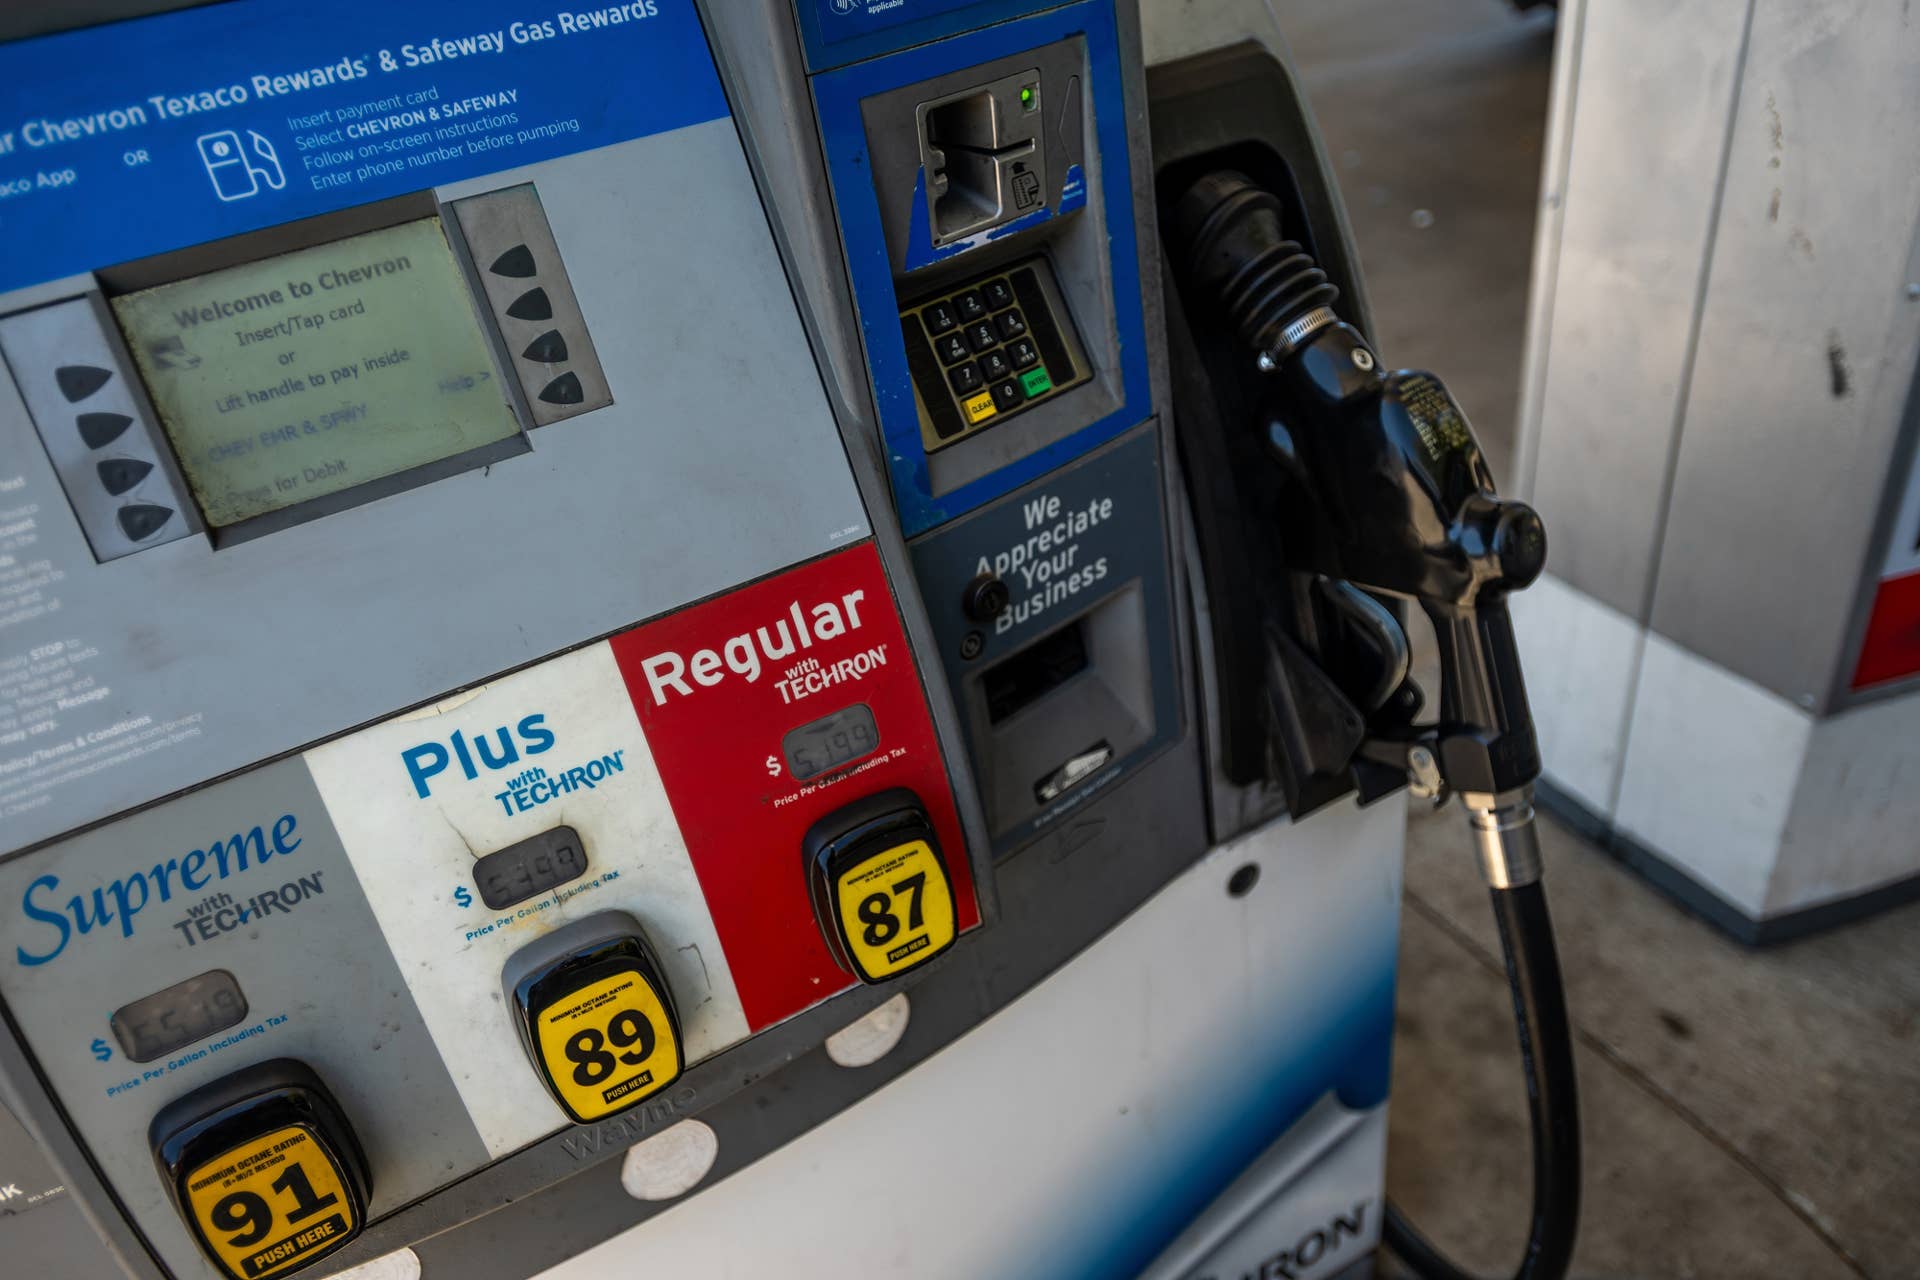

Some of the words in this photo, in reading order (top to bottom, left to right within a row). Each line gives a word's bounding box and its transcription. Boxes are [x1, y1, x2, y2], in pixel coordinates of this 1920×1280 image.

[868, 0, 904, 14] applicable
[22, 105, 147, 147] Chevron
[149, 85, 249, 120] Texaco
[252, 56, 368, 98] Rewards
[378, 50, 399, 72] &
[401, 30, 505, 68] Safeway
[509, 20, 555, 44] Gas
[557, 0, 659, 34] Rewards
[287, 113, 334, 131] Insert
[336, 95, 403, 122] payment
[406, 86, 440, 106] card
[295, 129, 343, 151] Select
[346, 110, 426, 139] CHEVRON
[428, 107, 441, 121] &
[442, 89, 519, 118] SAFEWAY
[124, 150, 150, 166] OR
[303, 149, 355, 170] Follow
[358, 132, 432, 159] on-screen
[436, 112, 519, 140] instructions
[310, 171, 352, 190] Enter
[357, 158, 404, 182] phone
[408, 145, 464, 168] number
[469, 132, 515, 154] before
[518, 118, 581, 144] pumping
[37, 169, 77, 189] App
[173, 286, 285, 329] Welcome
[288, 278, 314, 300] to
[318, 254, 412, 291] Chevron
[967, 297, 974, 307] 2
[995, 285, 1004, 296] 3
[236, 314, 326, 348] Insert/Tap
[329, 299, 366, 322] card
[980, 326, 988, 337] 5
[278, 349, 297, 367] or
[216, 389, 245, 416] Lift
[247, 375, 305, 405] handle
[310, 370, 327, 388] to
[331, 363, 360, 386] pay
[364, 346, 410, 373] inside
[1004, 385, 1013, 396] 0
[302, 420, 318, 435] &
[303, 459, 348, 483] Debit
[1023, 495, 1061, 530] We
[975, 497, 1113, 580] Appreciate
[1020, 544, 1079, 590] Your
[996, 557, 1108, 635] Business
[641, 589, 864, 706] Regular
[785, 657, 820, 681] with
[87, 714, 152, 744] Conditions
[401, 714, 555, 799] Plus
[506, 767, 546, 791] with
[766, 755, 782, 777] $
[774, 793, 798, 808] Price
[800, 785, 816, 797] Per
[890, 747, 907, 758] Tax
[17, 814, 302, 966] Supreme
[187, 892, 233, 919] with
[454, 886, 473, 909] $
[465, 925, 494, 941] Price
[496, 915, 515, 928] Per
[517, 900, 550, 919] Gallon
[551, 880, 600, 905] Including
[600, 870, 620, 882] Tax
[858, 870, 926, 947] 87
[890, 948, 909, 960] PUSH
[909, 938, 927, 951] HERE
[550, 1006, 582, 1023] MINIMUM
[582, 993, 608, 1008] OCTANE
[609, 981, 633, 996] RATING
[91, 1038, 113, 1062] $
[106, 1079, 141, 1098] Price
[142, 1067, 164, 1083] Per
[168, 1050, 208, 1071] Gallon
[208, 1024, 265, 1053] Including
[265, 1014, 289, 1028] Tax
[565, 1009, 656, 1086] 89
[606, 1085, 628, 1101] PUSH
[628, 1074, 649, 1090] HERE
[191, 1165, 237, 1193] MINIMUM
[238, 1148, 273, 1170] OCTANE
[273, 1133, 307, 1153] RATING
[255, 1154, 286, 1173] METHOD
[211, 1162, 338, 1247] 91
[254, 1241, 295, 1269] PUSH
[296, 1222, 335, 1248] HERE
